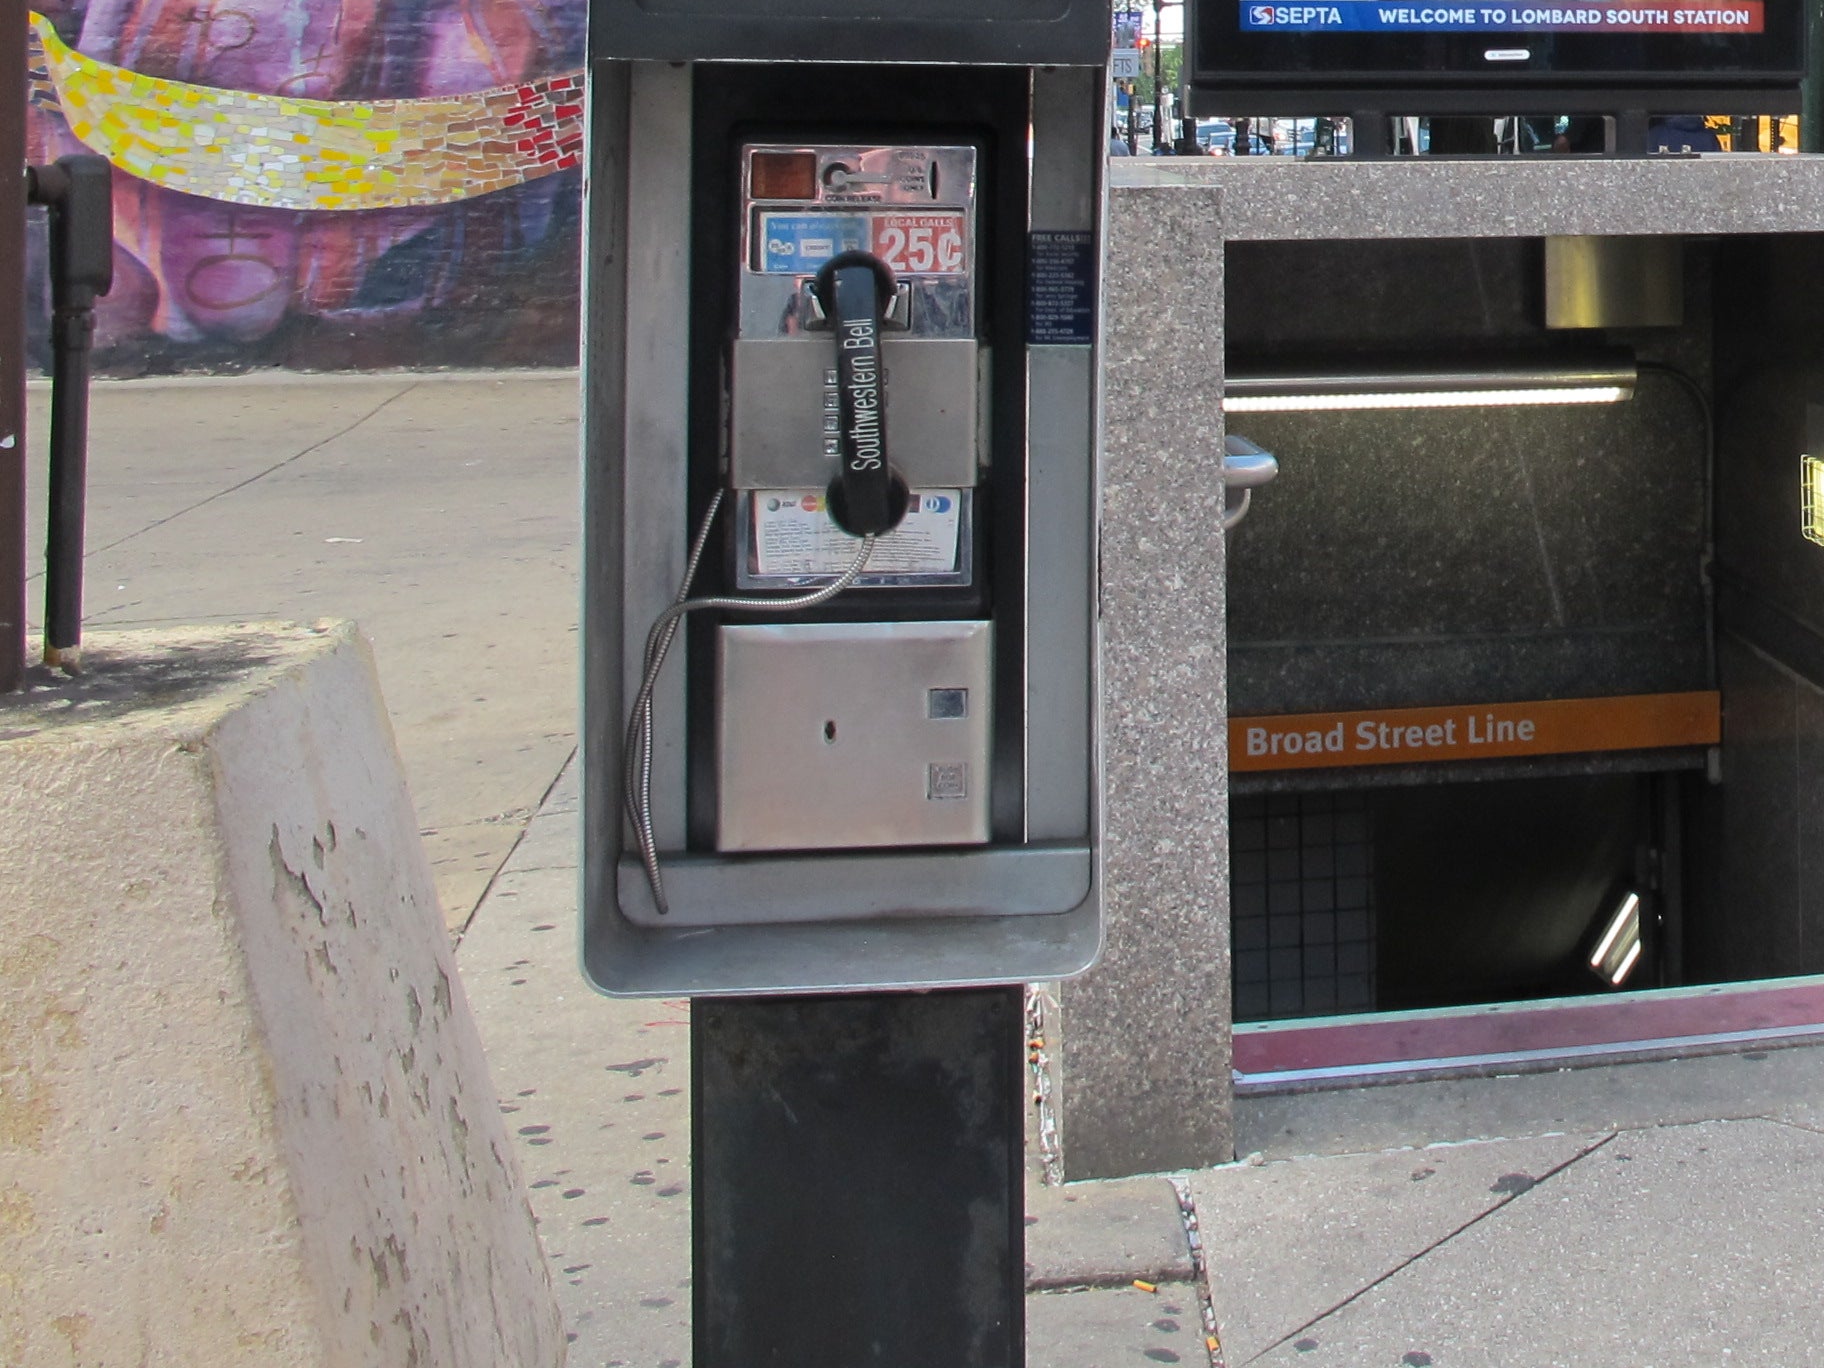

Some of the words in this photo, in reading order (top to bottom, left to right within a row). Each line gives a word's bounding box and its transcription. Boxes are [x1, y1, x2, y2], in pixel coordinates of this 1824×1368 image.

[1275, 7, 1342, 24] SEPTA
[1378, 9, 1475, 24] WELCOME
[1480, 9, 1506, 24] TO
[1511, 9, 1602, 24] LOMBARD
[1606, 9, 1668, 24] SOUTH
[1673, 10, 1750, 25] STATION
[886, 218, 916, 227] LOCAL
[879, 227, 963, 272] 25¢
[1031, 234, 1051, 242] FREE
[843, 318, 874, 350] Bell
[849, 355, 882, 471] Southwestern
[1246, 722, 1345, 756] Broad
[1355, 718, 1457, 751] Street
[1468, 713, 1536, 744] Line
